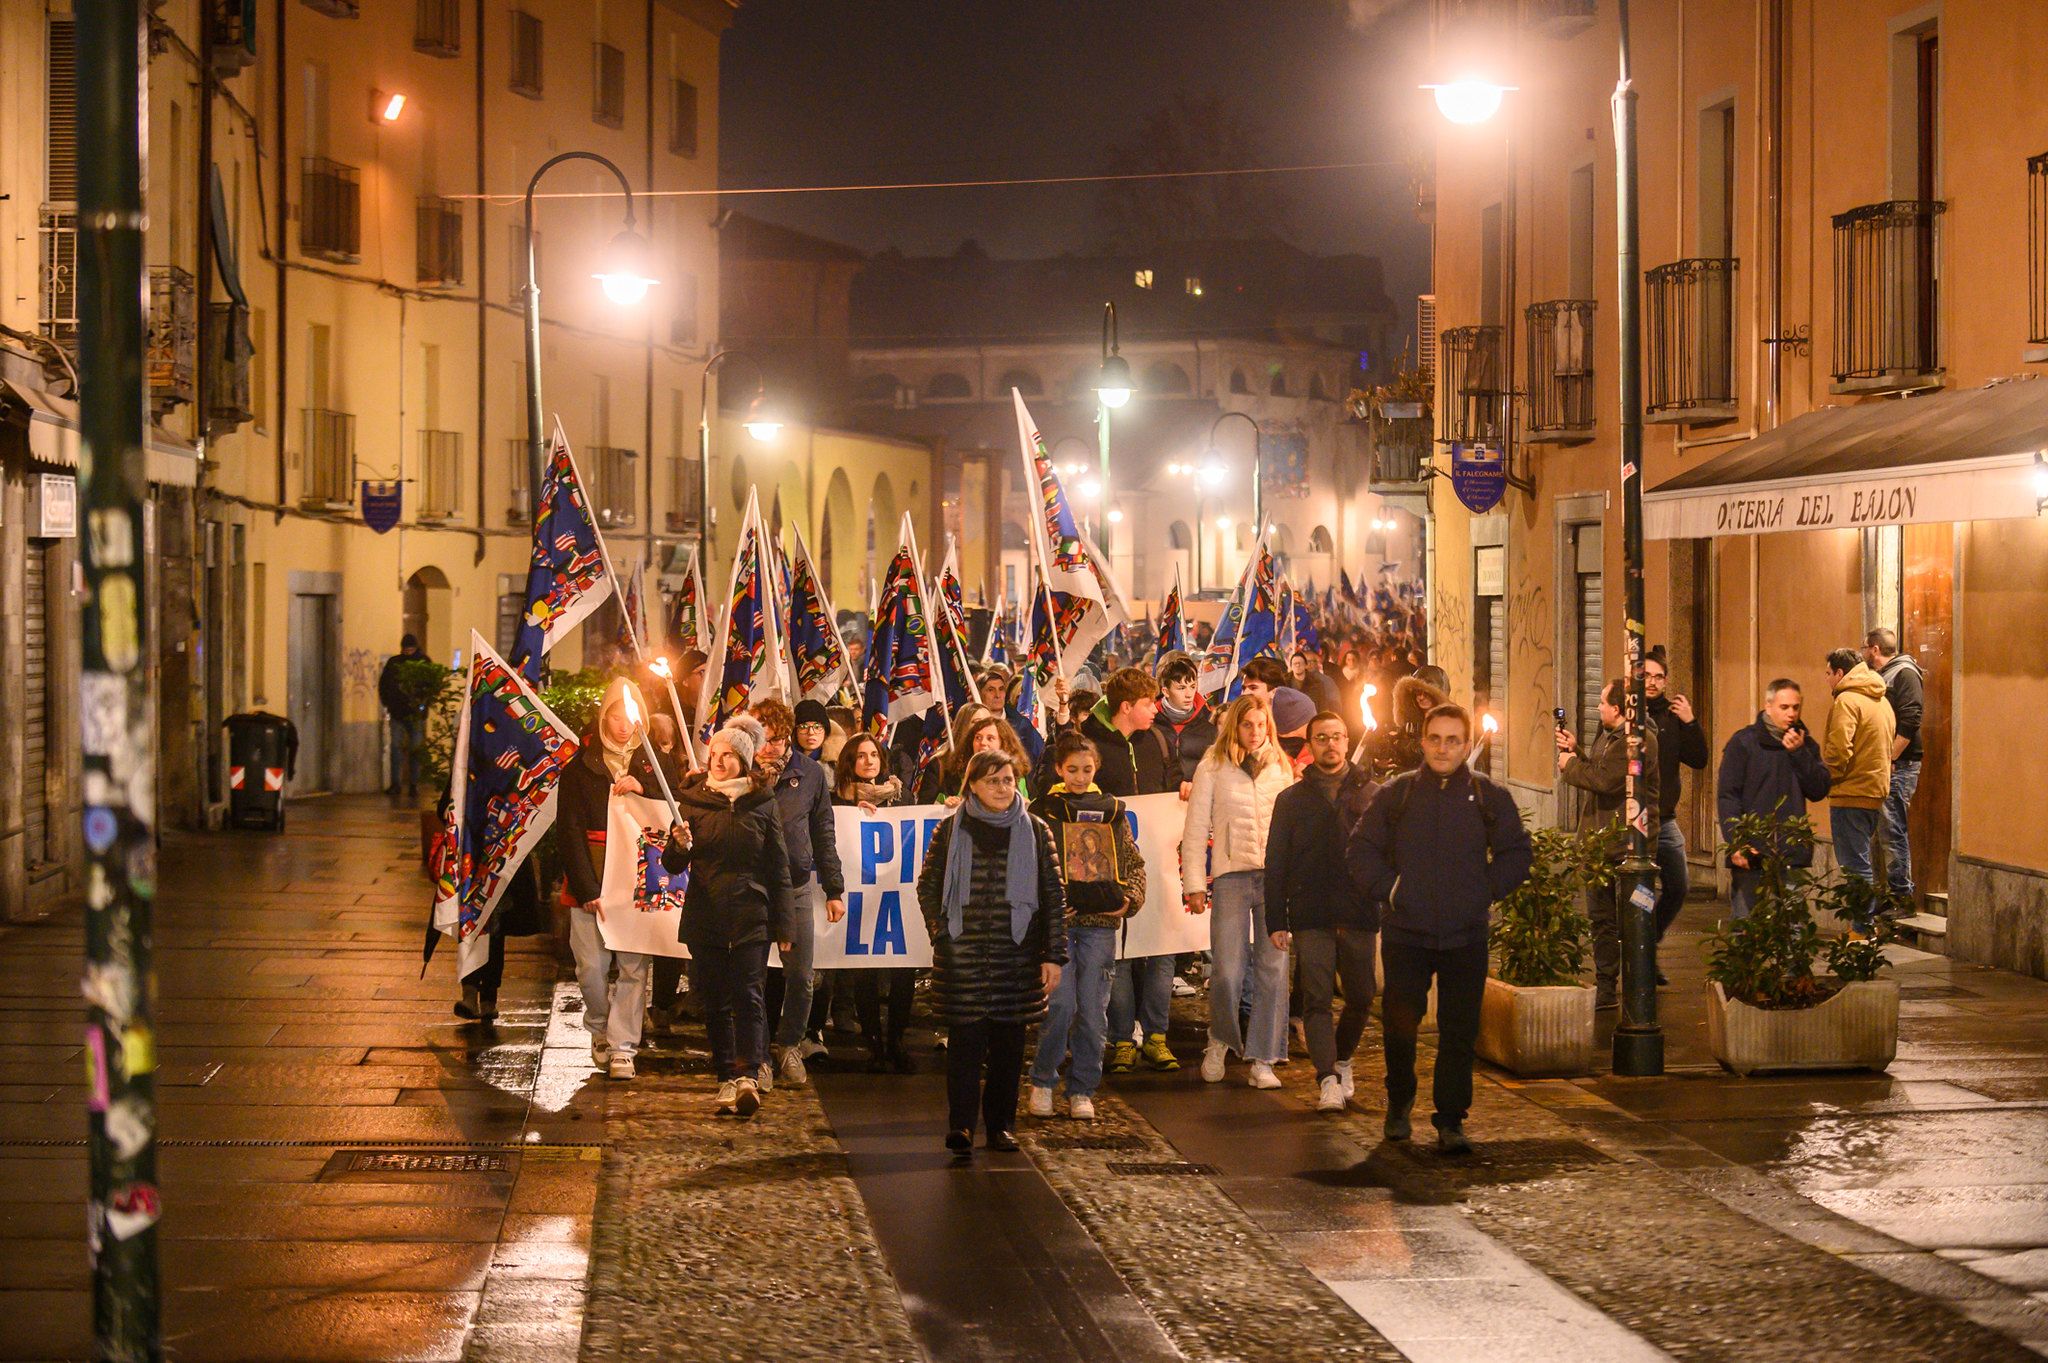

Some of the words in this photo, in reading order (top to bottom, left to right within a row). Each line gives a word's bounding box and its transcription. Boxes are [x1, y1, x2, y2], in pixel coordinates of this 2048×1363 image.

[1796, 494, 1833, 526] DEL
[1850, 486, 1917, 523] BALON
[845, 890, 908, 955] LA
